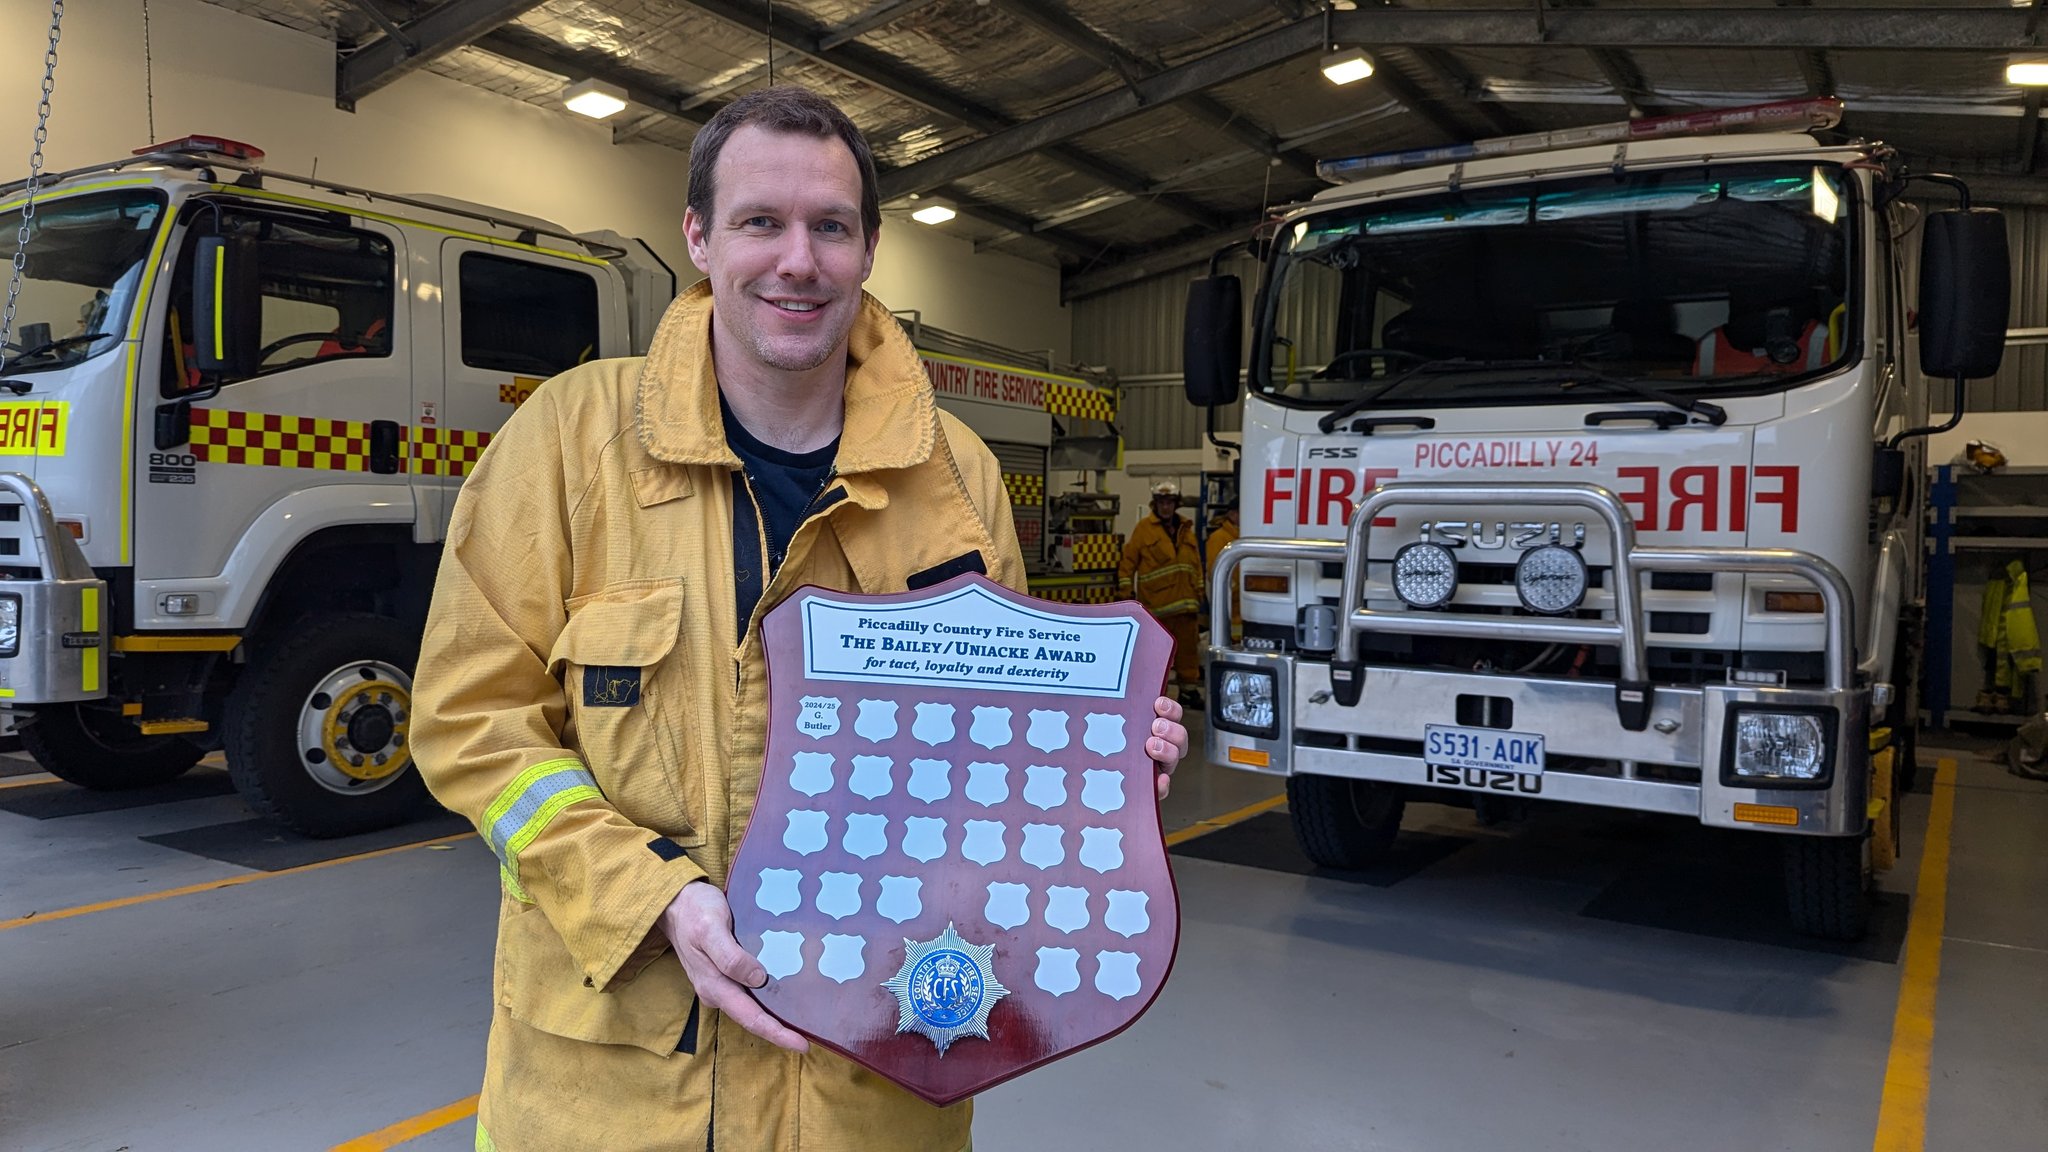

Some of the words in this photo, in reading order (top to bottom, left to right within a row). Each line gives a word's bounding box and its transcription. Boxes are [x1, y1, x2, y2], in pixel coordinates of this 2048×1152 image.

[973, 368, 998, 400] FIRE
[1001, 373, 1044, 407] SERVICE
[149, 453, 196, 467] 800
[1308, 447, 1359, 459] FSS
[1414, 441, 1563, 469] PICCADILLY
[1569, 440, 1599, 467] 24
[1420, 521, 1586, 549] ISUZU
[858, 617, 929, 635] Piccadilly
[933, 622, 992, 639] Country
[995, 626, 1024, 639] Fire
[1028, 628, 1081, 642] Service
[840, 634, 876, 650] THE
[1034, 646, 1097, 664] AWARD
[863, 656, 886, 670] for
[889, 658, 920, 672] tact,
[924, 660, 973, 676] loyalty
[977, 664, 1005, 675] and
[1007, 665, 1070, 682] dexterity
[804, 701, 836, 709] 2024/25
[814, 711, 824, 719] G.
[803, 721, 832, 730] Butler
[1463, 760, 1515, 770] GOVERNMENT
[1426, 763, 1543, 794] ISUZU
[914, 960, 933, 1000] COUNTRY
[963, 963, 977, 981] FIRE
[934, 978, 958, 1000] CFS
[954, 985, 979, 1019] SERVICE
